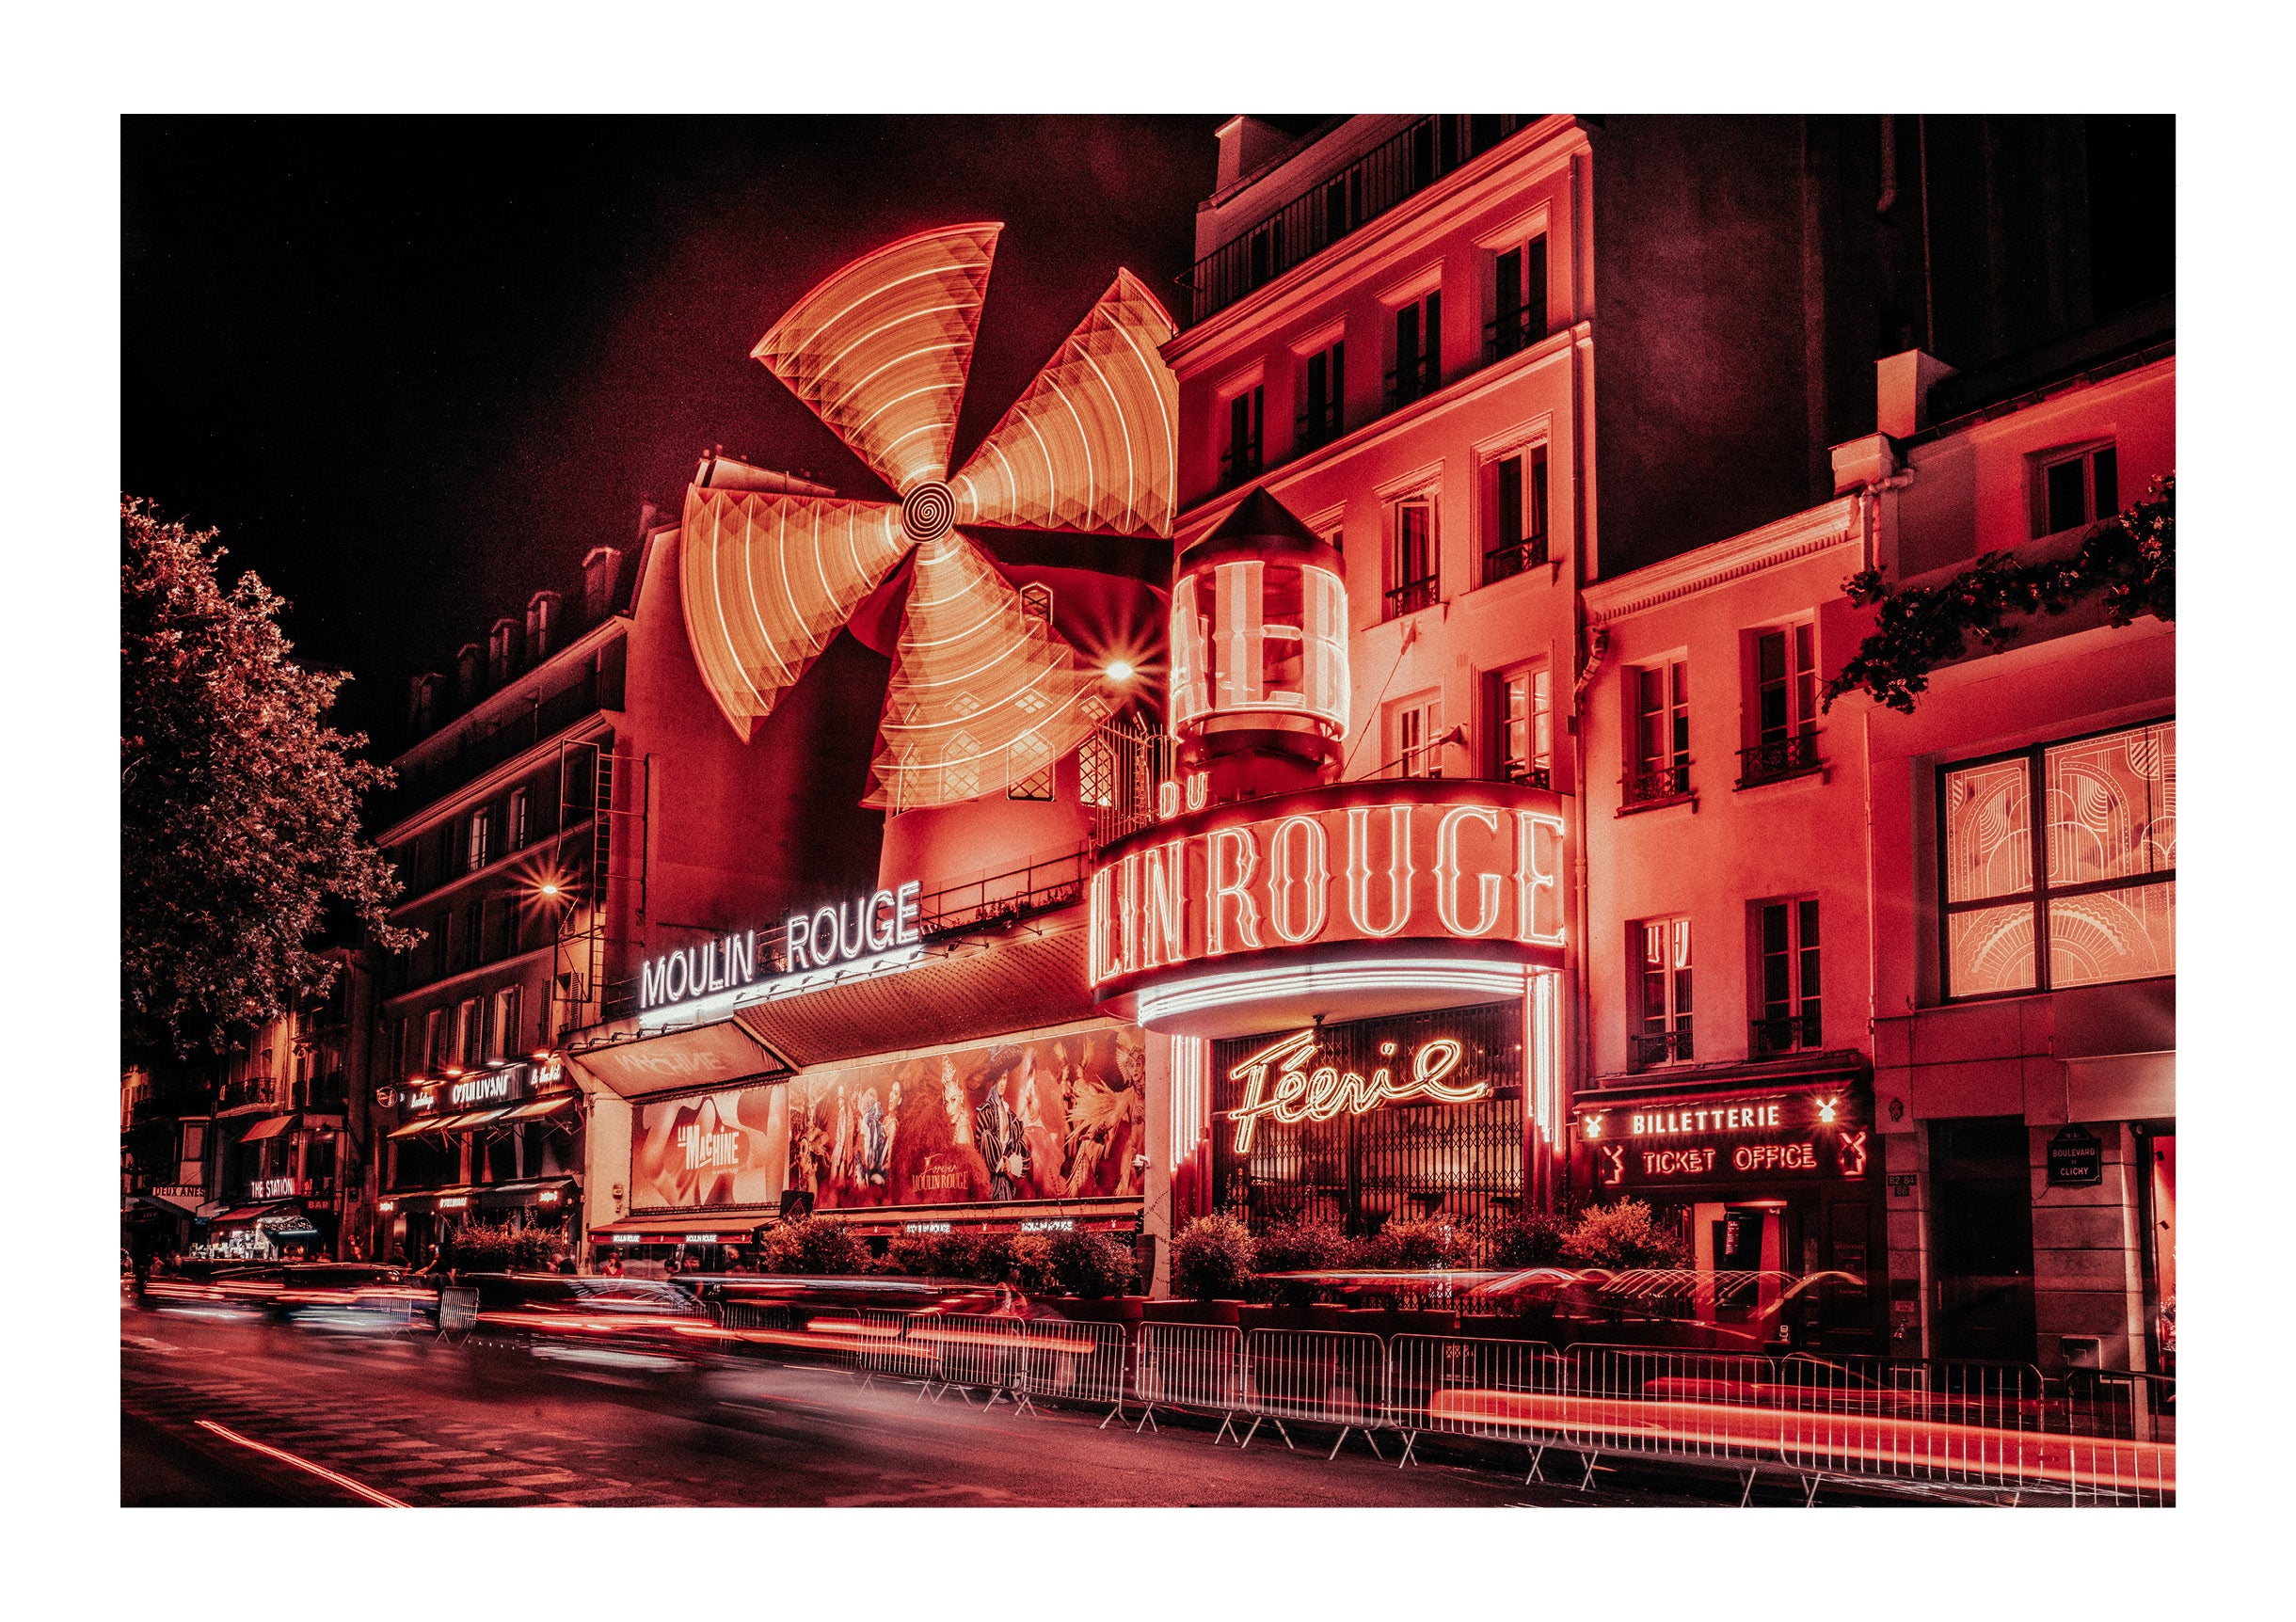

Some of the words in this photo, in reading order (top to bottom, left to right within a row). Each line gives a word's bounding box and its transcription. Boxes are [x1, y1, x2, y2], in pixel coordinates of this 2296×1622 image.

[1159, 771, 1208, 819] DU
[1207, 805, 1565, 954] ROUGE
[641, 930, 754, 1009] MOULIN
[787, 880, 922, 973] ROUGE
[1229, 1029, 1492, 1155] Féerie
[1633, 1105, 1780, 1135] BILLETTERIE
[1643, 1149, 1716, 1174] TICKET
[1735, 1143, 1818, 1171] OFFICE
[2052, 1148, 2096, 1157] BOULEVARD
[912, 1173, 940, 1192] MOULIN
[941, 1171, 968, 1190] ROUGE
[1889, 1176, 1901, 1185] 82
[1904, 1176, 1915, 1185] 84
[2061, 1167, 2089, 1176] CLICHY
[155, 1186, 177, 1197] DEUX
[251, 1181, 264, 1199] THE
[265, 1178, 293, 1199] STATION
[1897, 1186, 1907, 1195] 86
[308, 1201, 328, 1210] BAR
